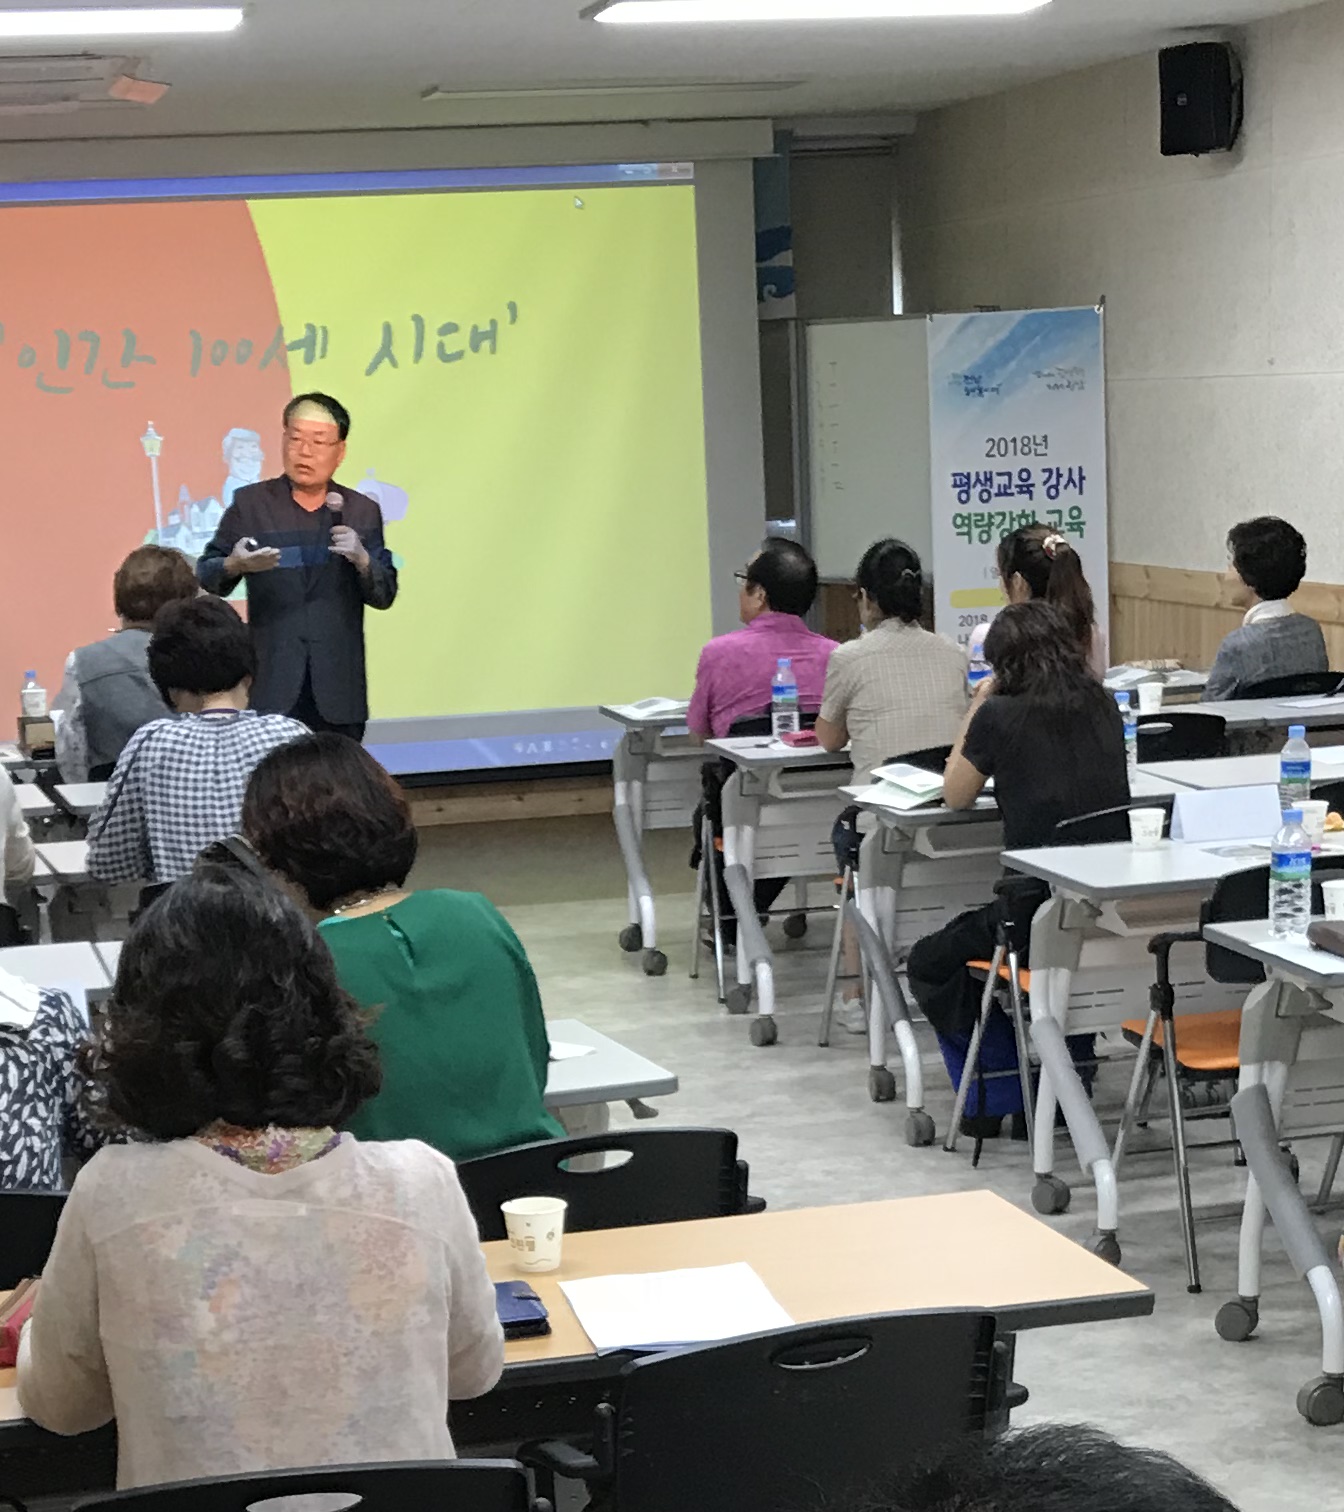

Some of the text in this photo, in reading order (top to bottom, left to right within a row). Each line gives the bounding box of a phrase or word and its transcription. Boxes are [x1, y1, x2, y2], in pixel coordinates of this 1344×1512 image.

[189, 322, 328, 377] 100세
[985, 434, 1049, 458] 2018년
[951, 466, 1086, 504] 평생교육 강사
[1045, 506, 1086, 539] 교육
